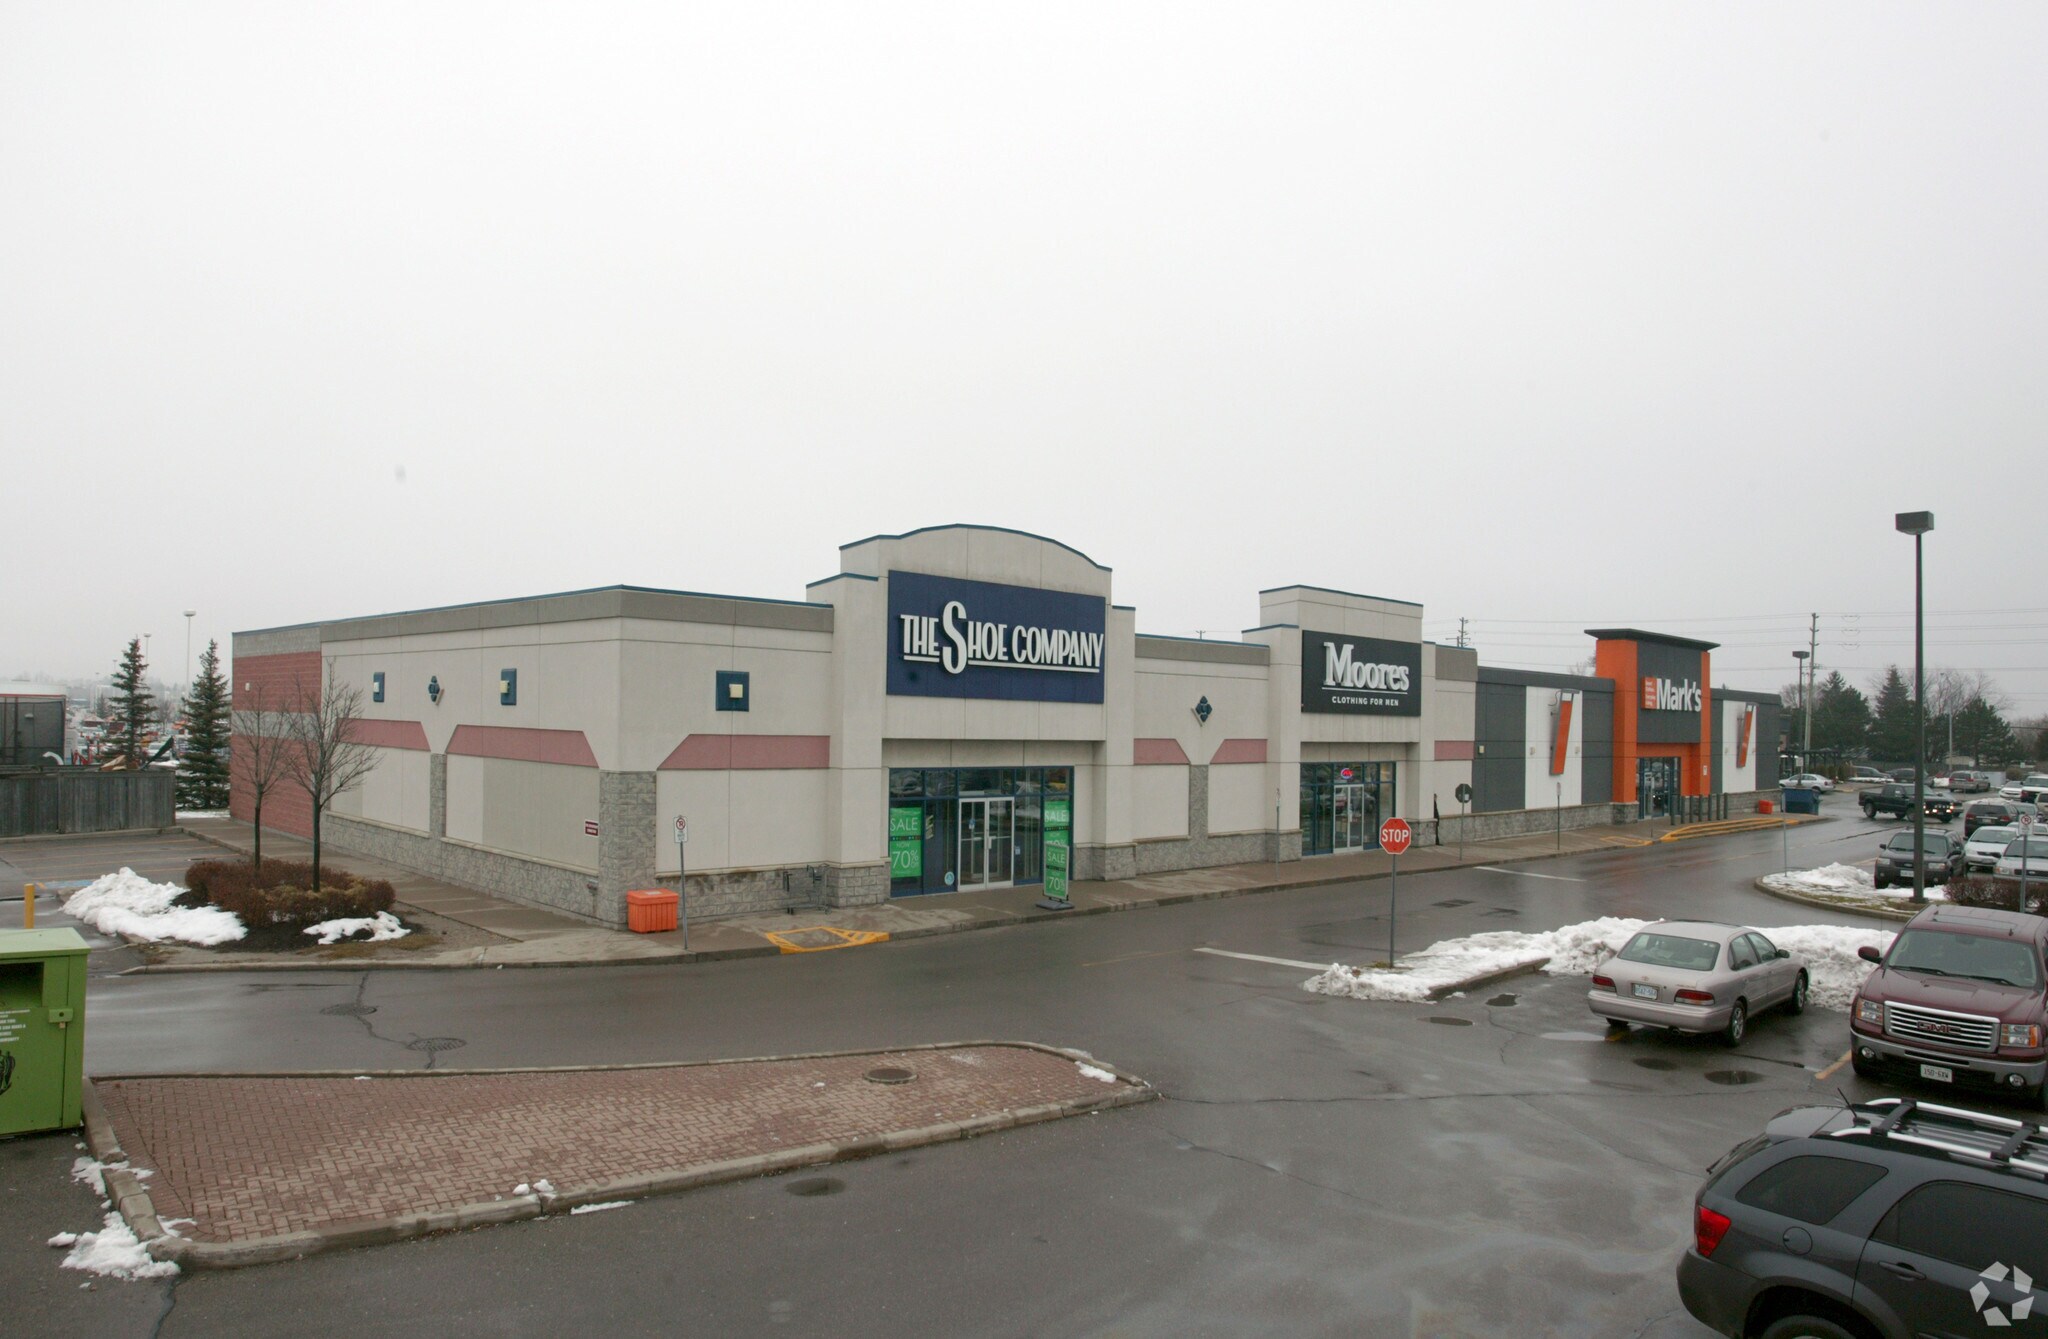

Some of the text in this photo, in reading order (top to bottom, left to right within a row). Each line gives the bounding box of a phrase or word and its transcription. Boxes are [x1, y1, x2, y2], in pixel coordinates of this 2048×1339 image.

[900, 600, 1104, 675] THE SHOE COMPANY
[1323, 641, 1410, 691] Moores
[1331, 695, 1399, 707] CLOTHING FOR MEN
[1656, 678, 1702, 713] Mark's
[1045, 810, 1067, 823] SALE
[890, 817, 918, 831] SALE
[1381, 829, 1409, 843] STOP
[1047, 851, 1066, 864] SALE
[1917, 1019, 1961, 1036] GMC
